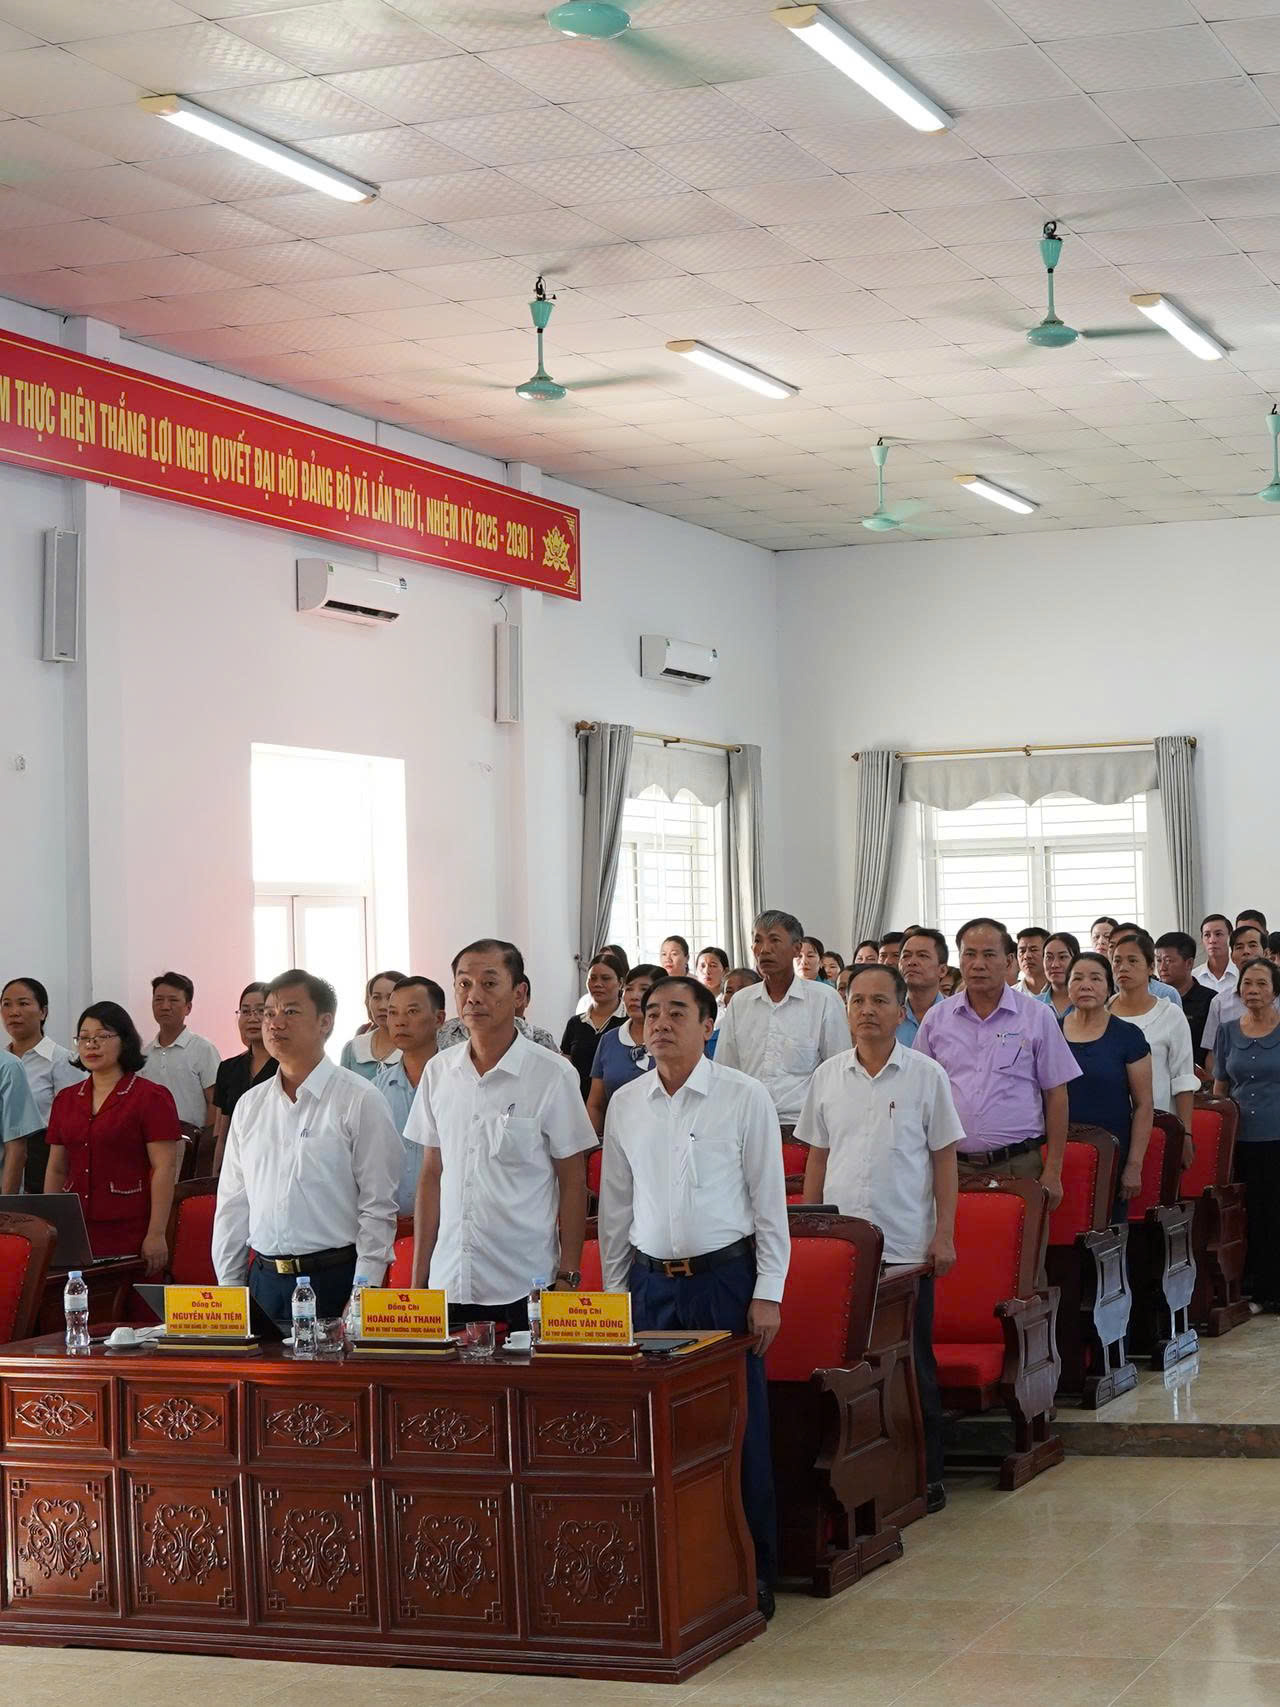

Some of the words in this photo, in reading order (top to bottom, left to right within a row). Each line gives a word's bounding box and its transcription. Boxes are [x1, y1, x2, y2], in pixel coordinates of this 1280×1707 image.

[15, 379, 55, 442] THỰC
[60, 386, 96, 452] HIỆN
[100, 391, 147, 458] THẮNG
[151, 416, 172, 473] LỢI
[176, 424, 208, 484] NGHỊ
[212, 429, 251, 486] QUYẾT
[254, 446, 275, 500] ĐẠI
[278, 448, 298, 506] HỘI
[301, 449, 333, 508] ĐẢNG
[336, 464, 351, 521] BỘ
[354, 471, 369, 518] XÃ
[372, 470, 392, 524] LẦN
[395, 483, 415, 529] THỨ
[417, 494, 424, 536] I,
[427, 494, 458, 547] NHIỆM
[461, 501, 473, 544] KỲ
[476, 511, 498, 551] 2025
[506, 521, 528, 560] 2030
[530, 527, 534, 560] !
[172, 1310, 204, 1321] NGUYỄN
[568, 1307, 587, 1315] Đồng
[367, 1314, 395, 1323] HOÀNG
[414, 1316, 441, 1324] THANH
[548, 1318, 577, 1328] HOÀNG
[580, 1318, 597, 1328] VĂN
